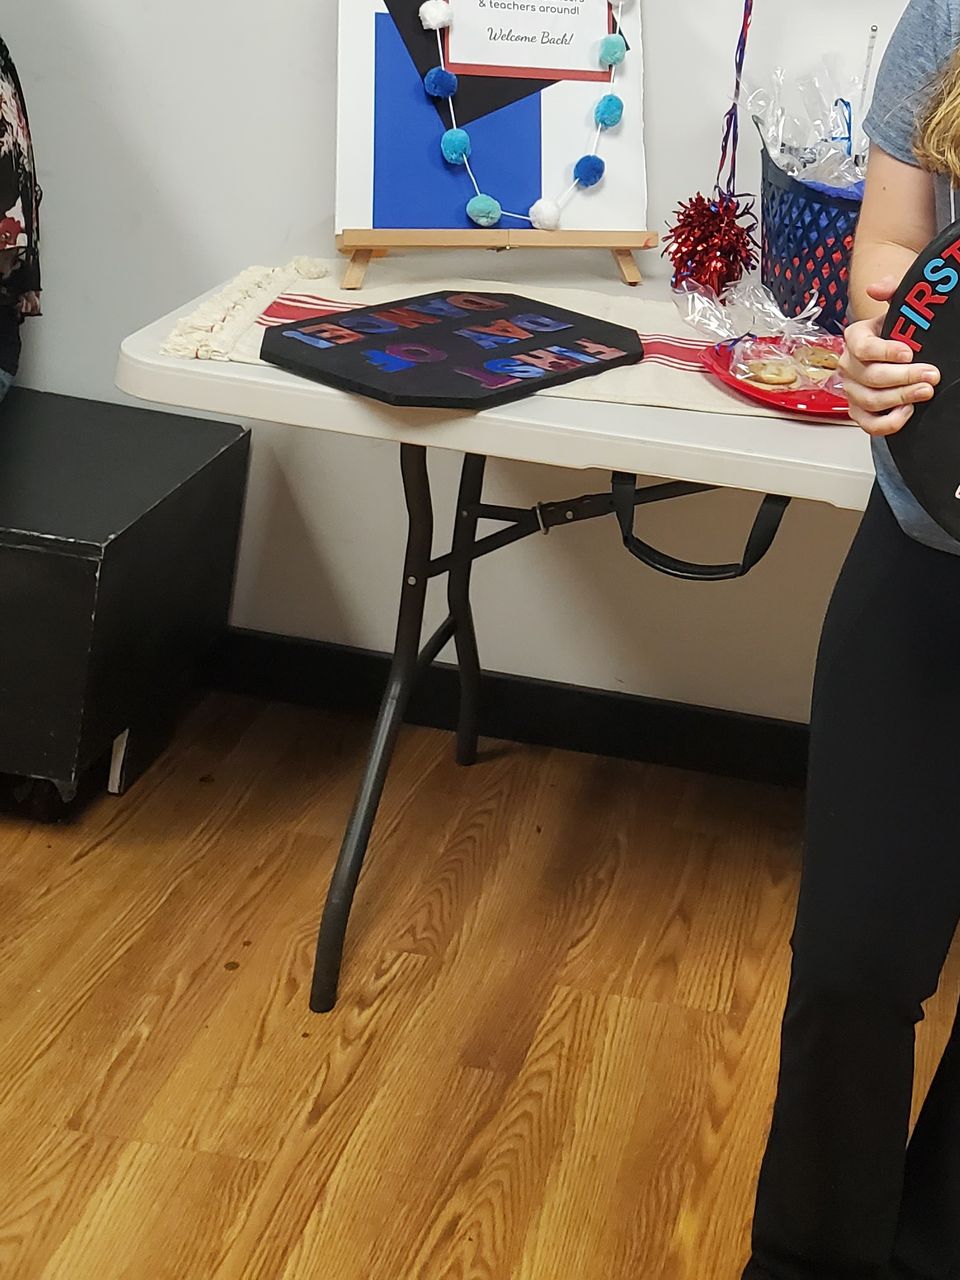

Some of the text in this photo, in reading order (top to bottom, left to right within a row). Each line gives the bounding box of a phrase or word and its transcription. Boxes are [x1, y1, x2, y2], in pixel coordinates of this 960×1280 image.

[489, 0, 536, 12] teachers
[538, 5, 580, 16] around!
[487, 27, 574, 46] Welcome Back!
[453, 313, 574, 350] DAY
[361, 342, 449, 373] OF
[455, 338, 627, 389] FIRST
